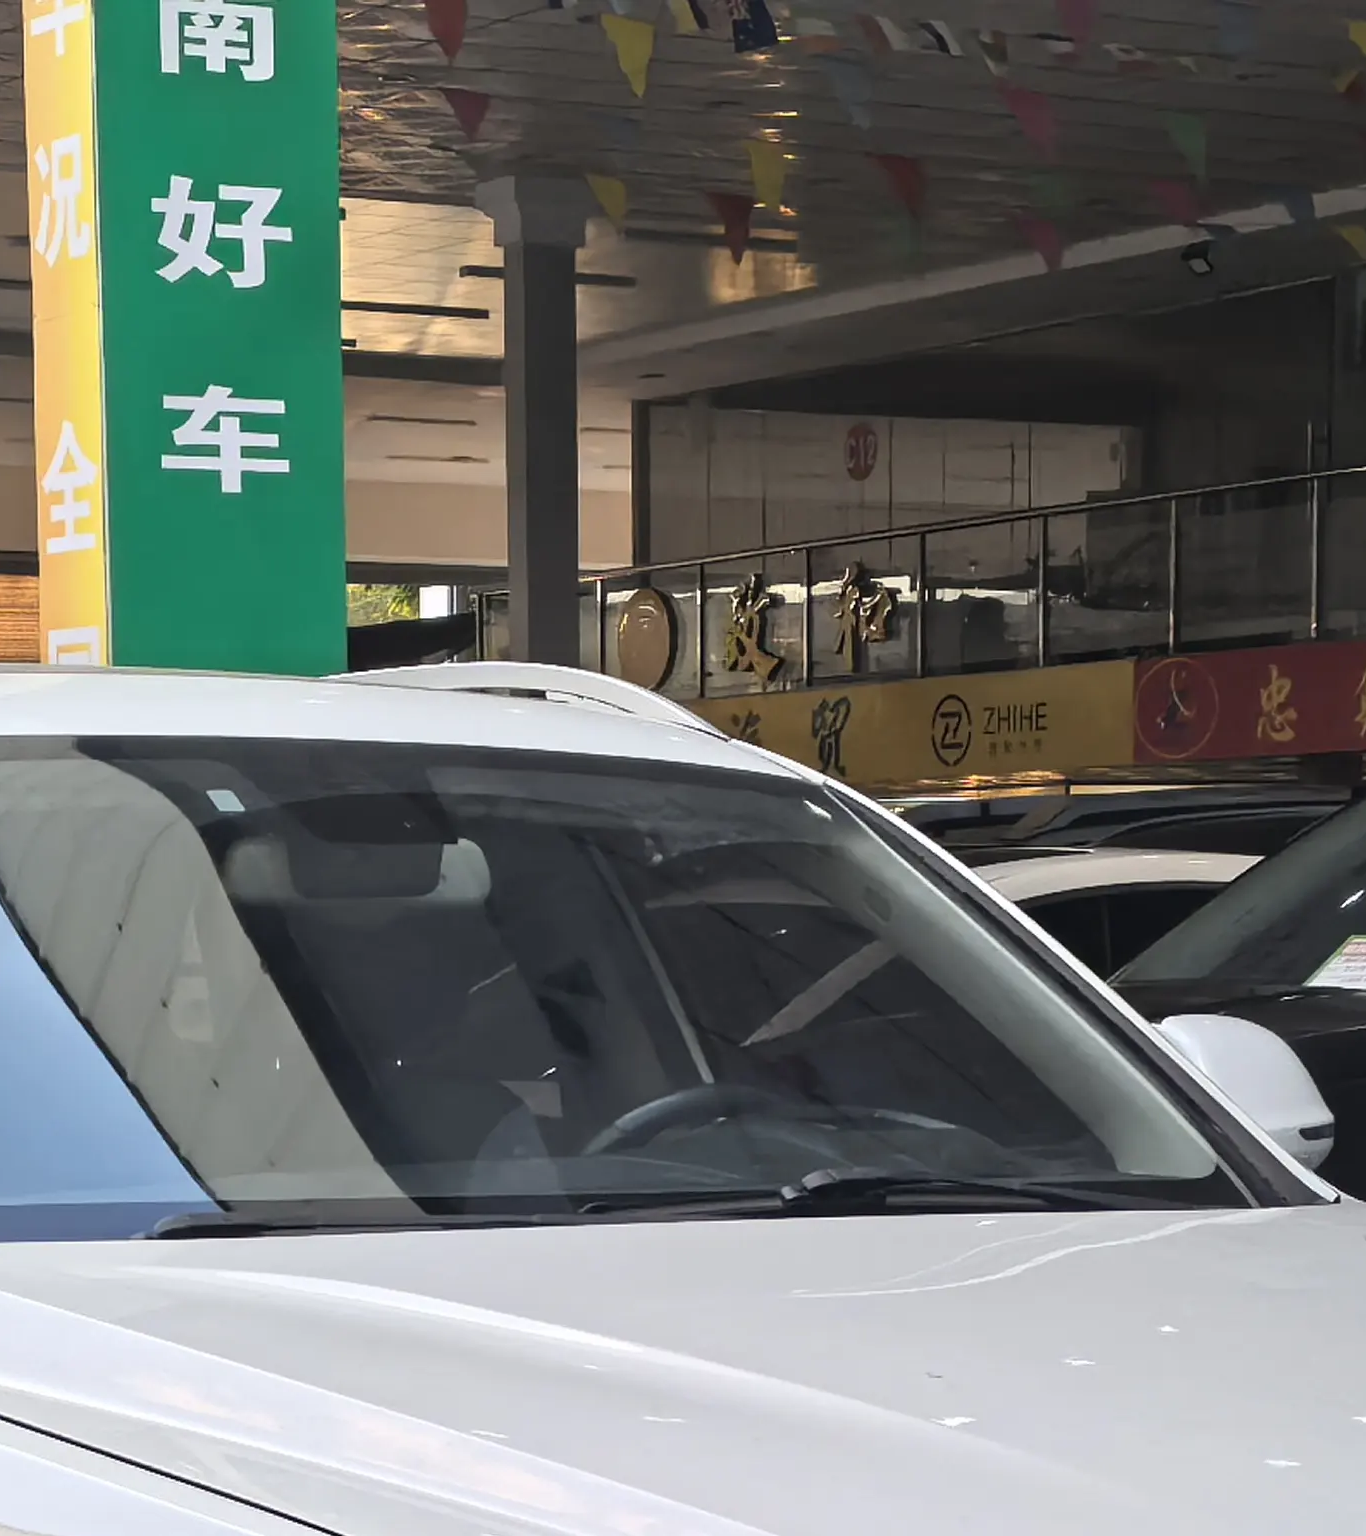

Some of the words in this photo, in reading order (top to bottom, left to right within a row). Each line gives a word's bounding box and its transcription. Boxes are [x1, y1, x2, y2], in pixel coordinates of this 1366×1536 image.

[31, 0, 100, 664] 况全
[151, 0, 293, 494] 南好车
[982, 701, 1048, 735] ZHIHE
